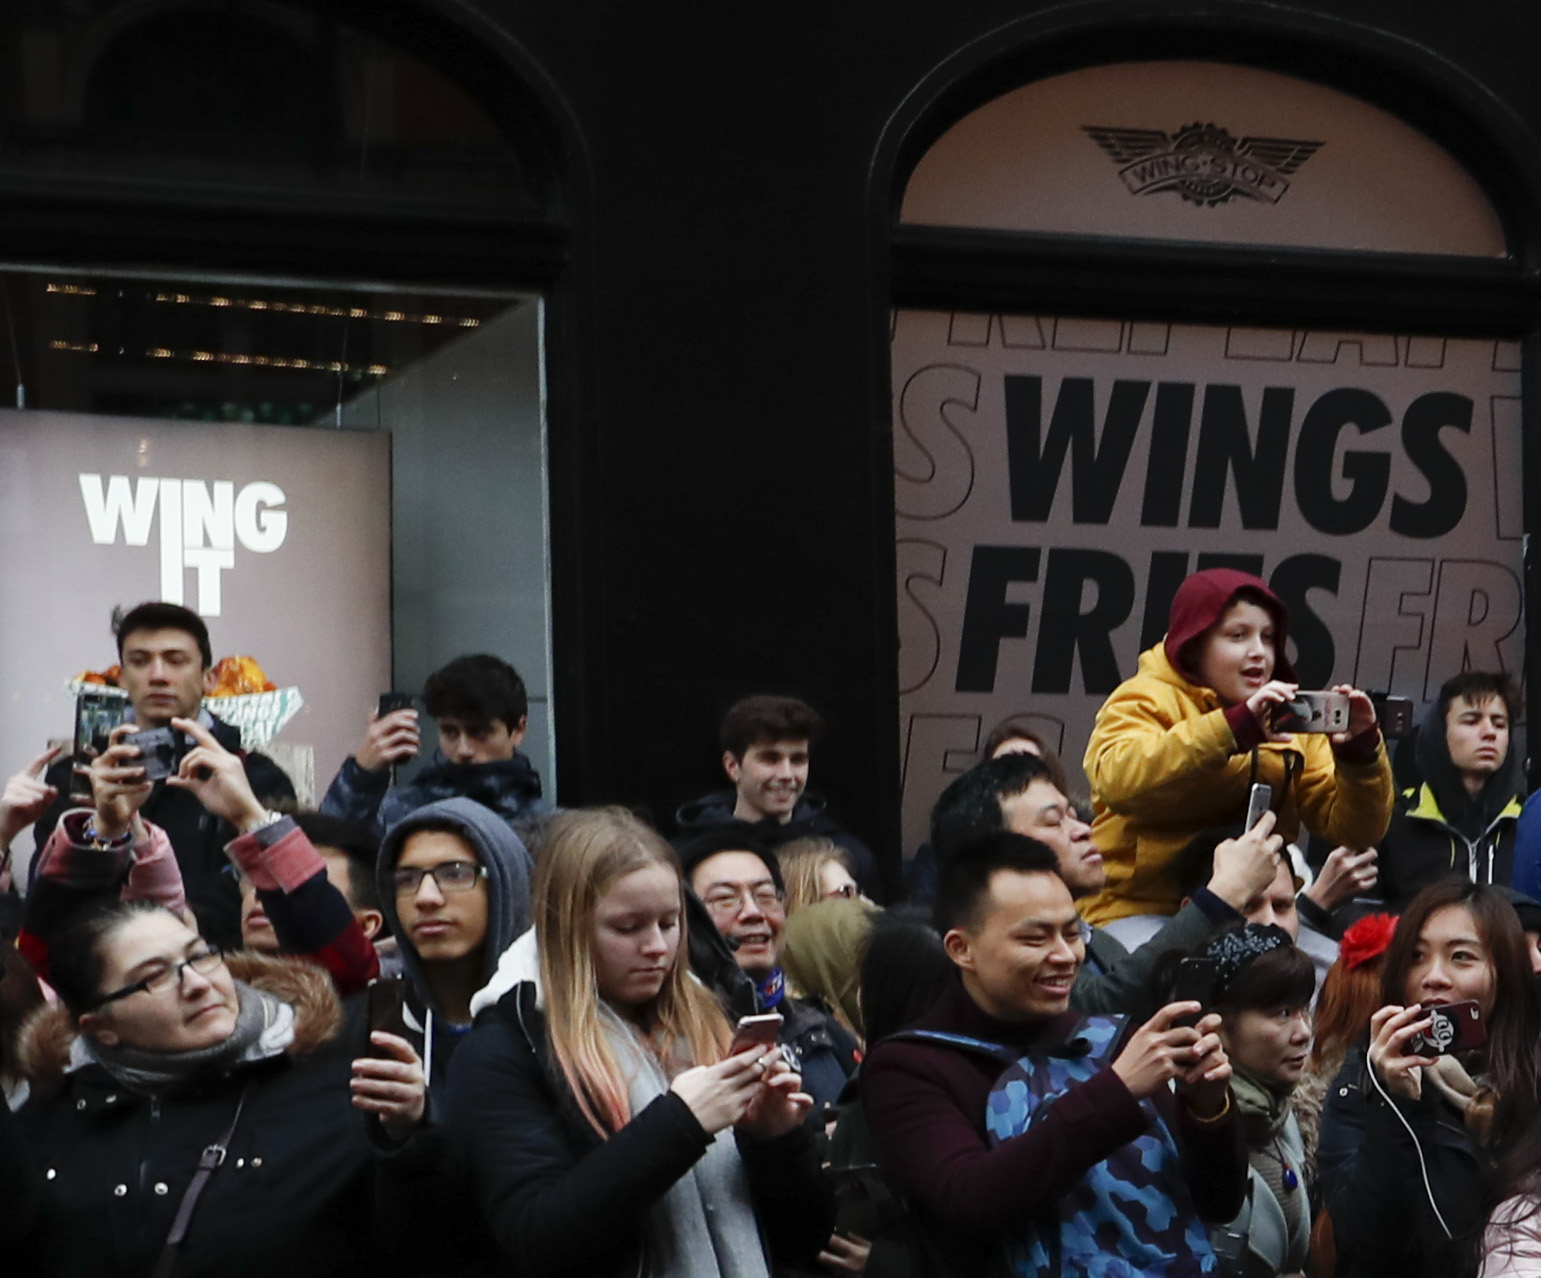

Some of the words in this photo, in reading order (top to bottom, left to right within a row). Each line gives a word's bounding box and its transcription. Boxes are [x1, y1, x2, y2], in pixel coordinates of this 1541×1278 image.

[79, 473, 288, 553] WING
[1004, 374, 1475, 539] WINGS
[159, 532, 235, 617] IT
[954, 545, 1342, 697] FRIS
